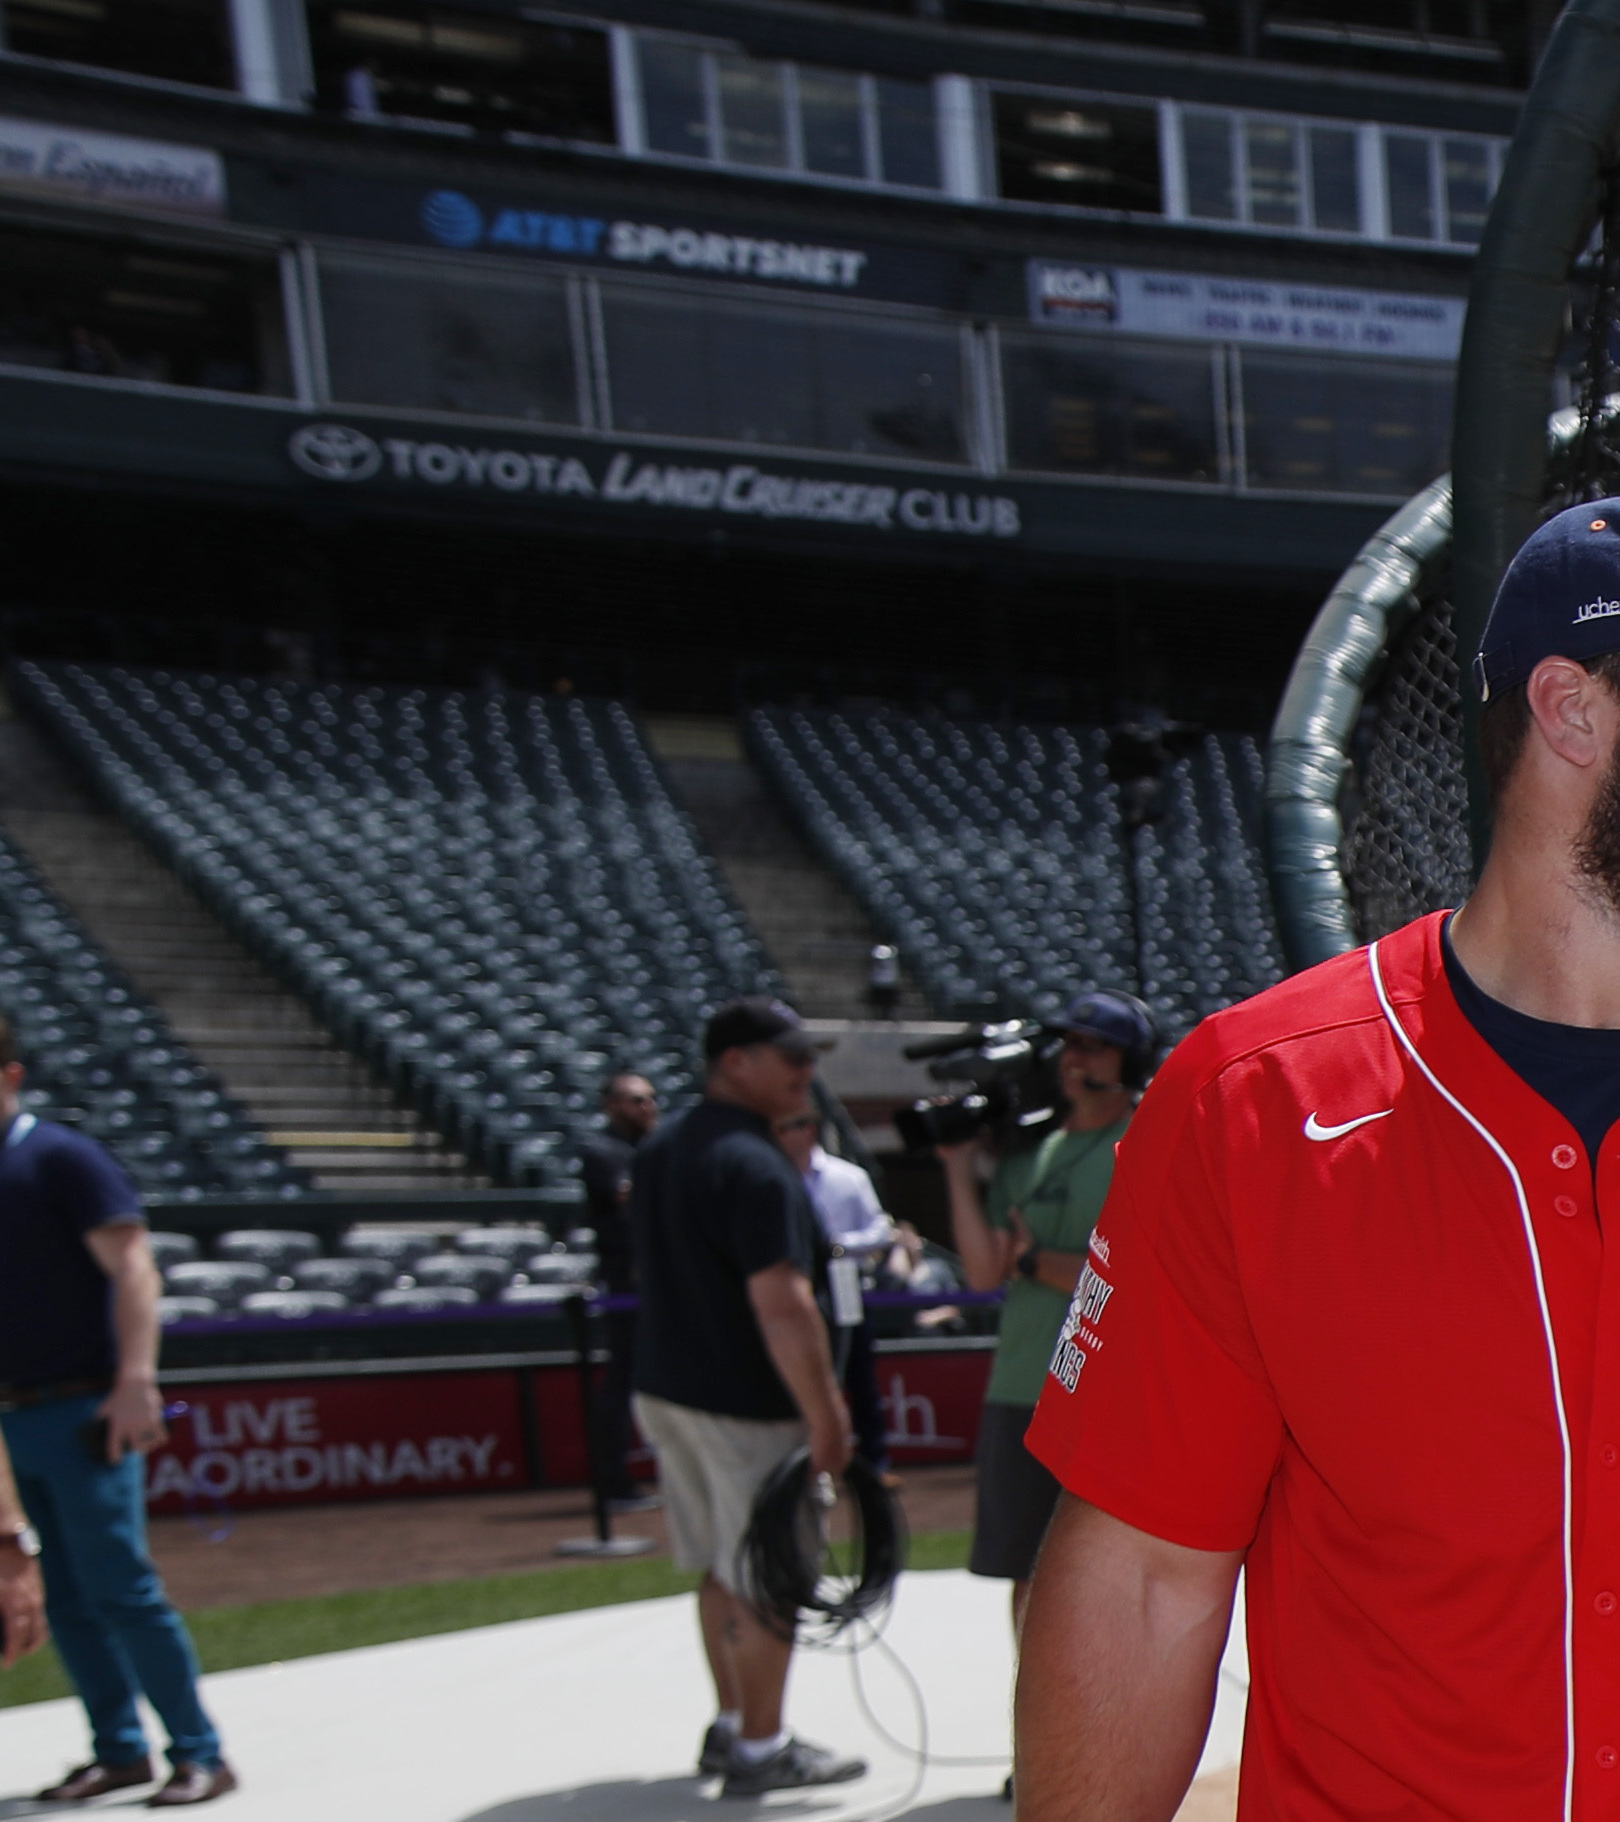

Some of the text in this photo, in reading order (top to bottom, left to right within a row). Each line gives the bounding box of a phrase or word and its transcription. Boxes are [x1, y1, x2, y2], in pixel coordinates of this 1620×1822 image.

[488, 209, 867, 288] AT&T SPORTSNET
[1042, 266, 1113, 298] KOA
[383, 440, 595, 495] TOYOTA
[900, 491, 1022, 538] CLUB
[193, 1396, 320, 1448] LIVE
[145, 1433, 514, 1502] AORDINARY.
